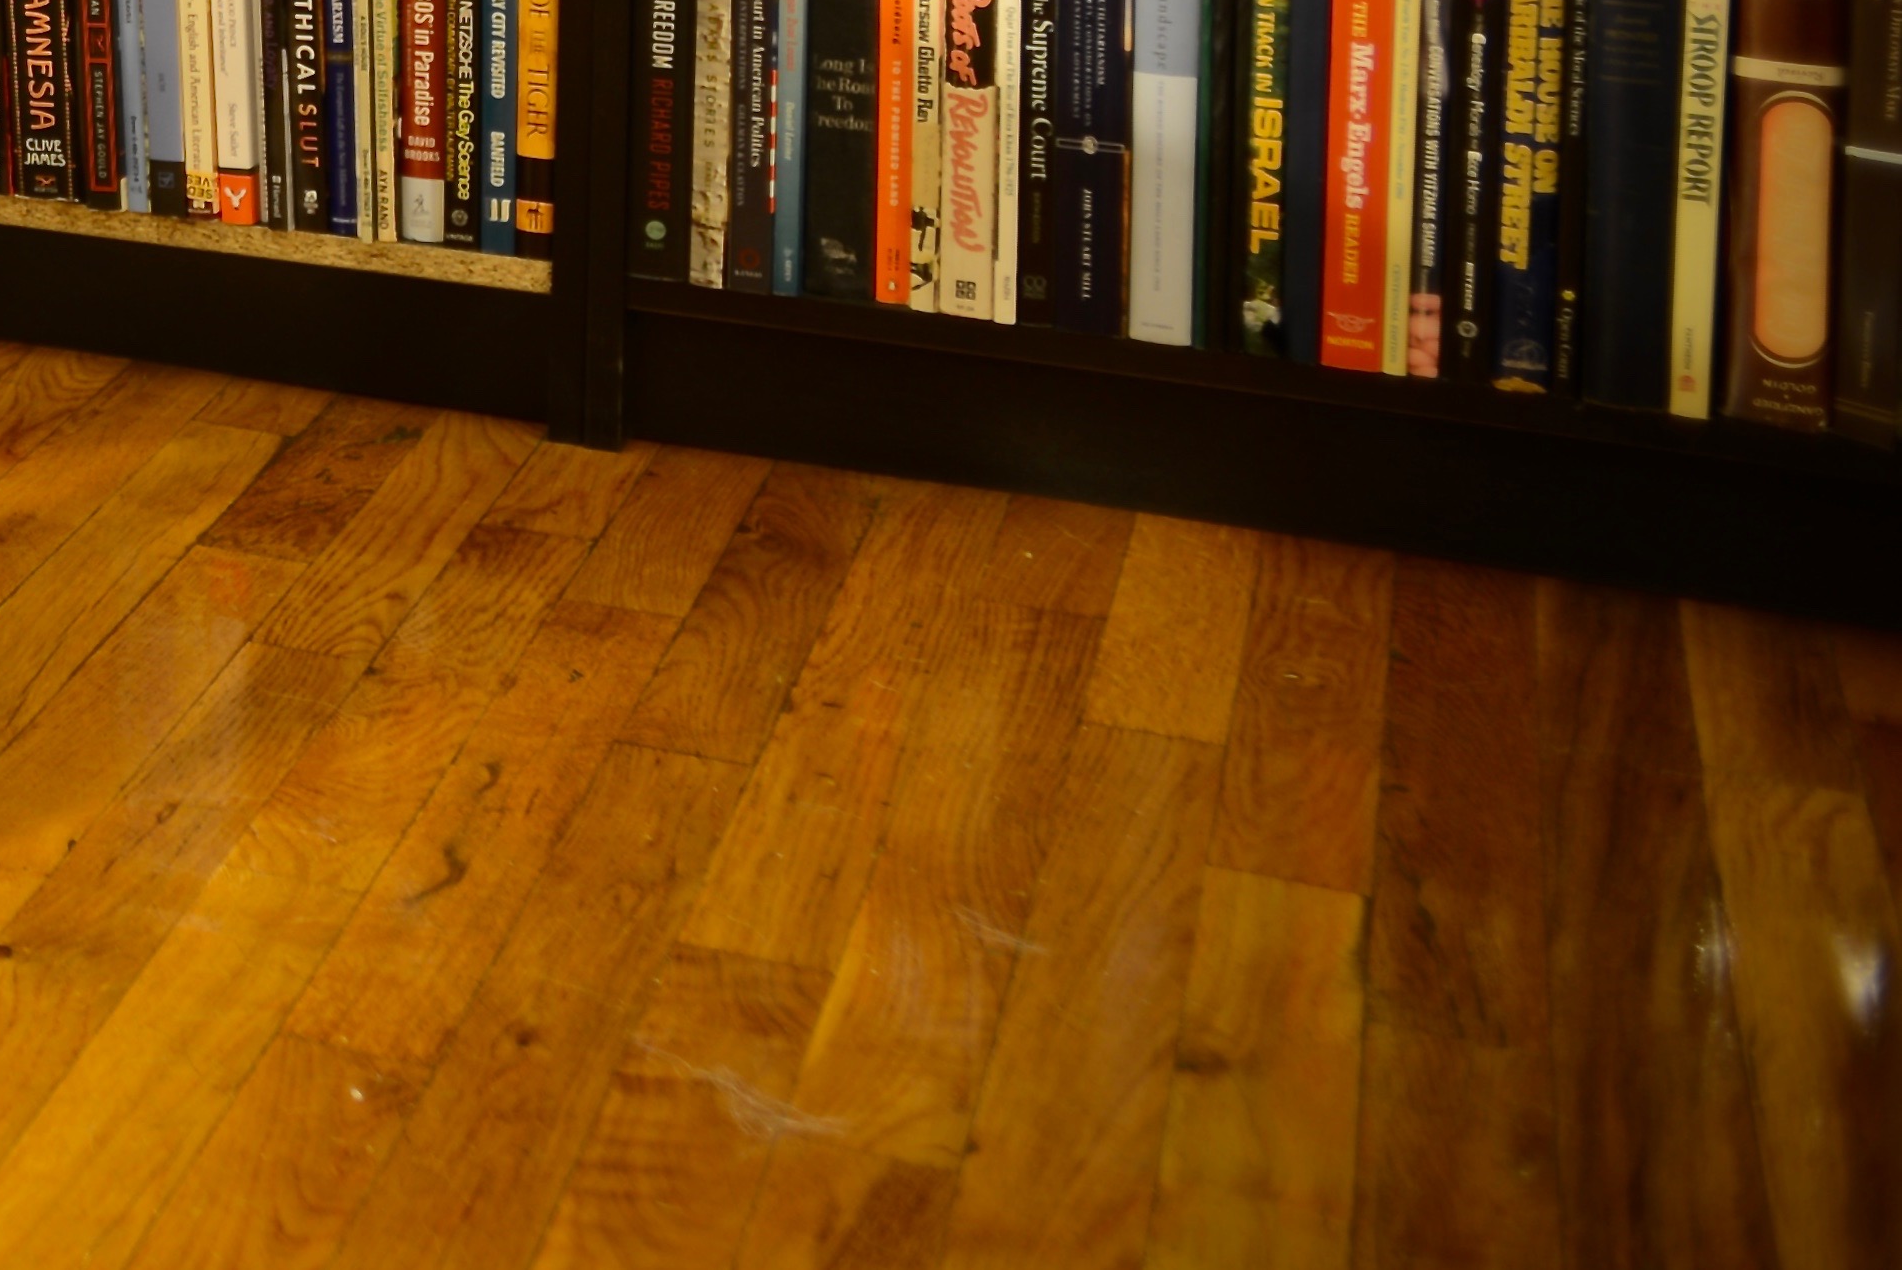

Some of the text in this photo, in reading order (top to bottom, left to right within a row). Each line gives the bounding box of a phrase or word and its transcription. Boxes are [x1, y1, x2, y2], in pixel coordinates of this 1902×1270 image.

[1030, 20, 1053, 110] Supreme
[25, 153, 65, 166] JAMES
[26, 138, 61, 153] CLIVE
[297, 105, 318, 168] SLUT
[1029, 118, 1053, 178] Court
[1250, 100, 1283, 253] ISRAEL
